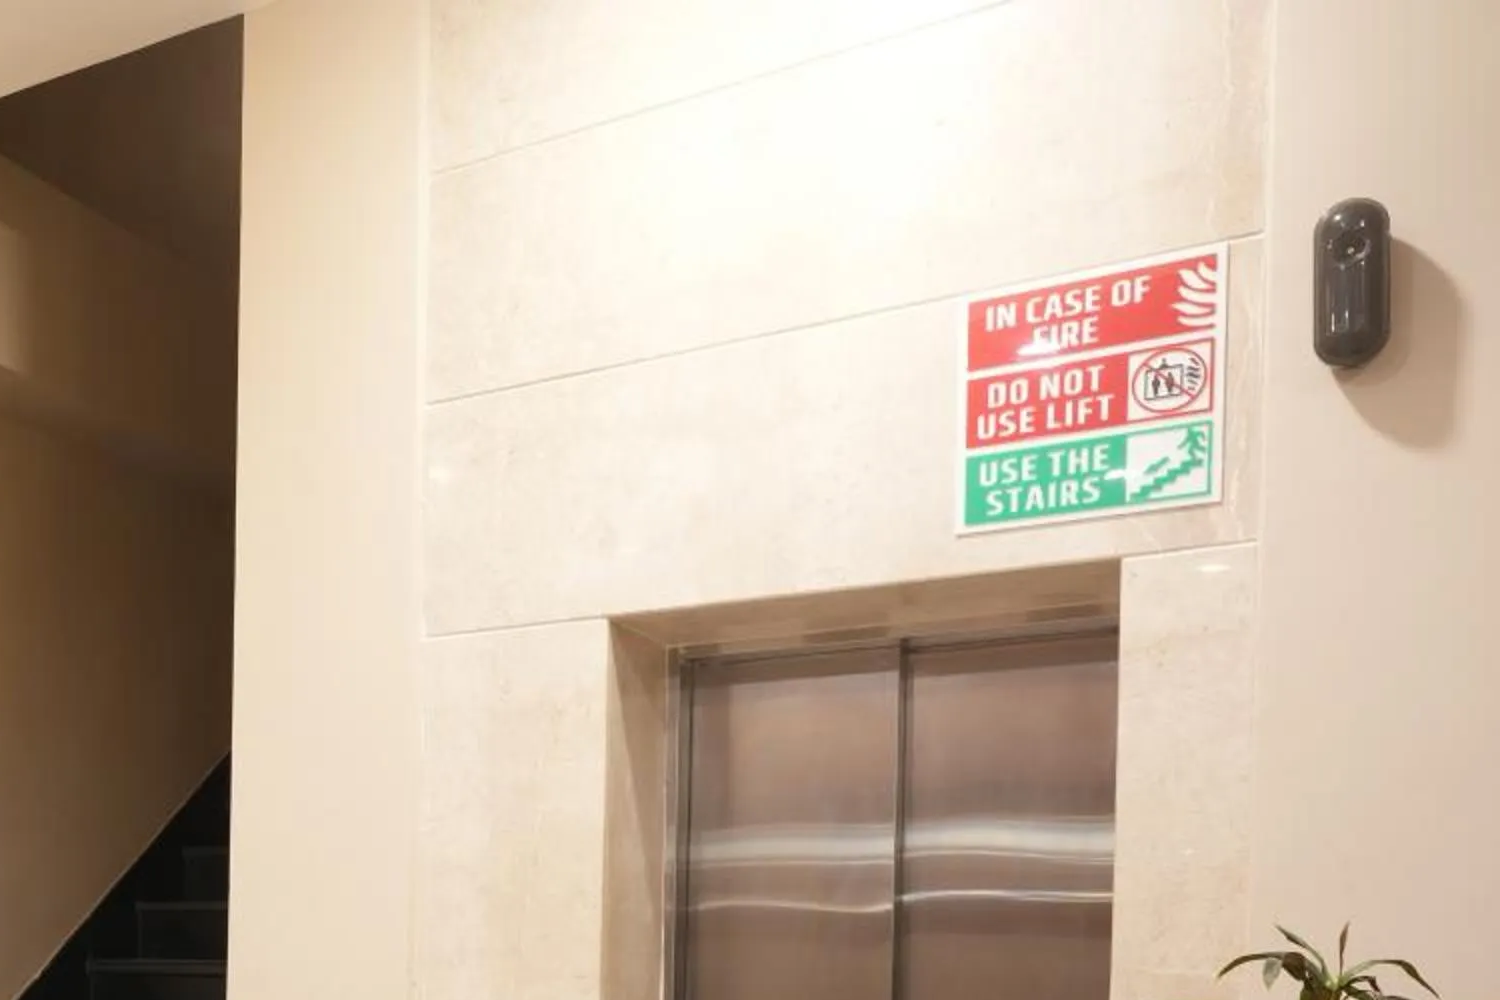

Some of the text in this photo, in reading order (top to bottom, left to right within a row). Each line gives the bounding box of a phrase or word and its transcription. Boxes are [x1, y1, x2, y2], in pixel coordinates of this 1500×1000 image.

[985, 275, 1152, 332] IN CASE OF
[1032, 316, 1099, 351] FIRE
[987, 365, 1105, 409] DO NOT
[976, 394, 1115, 440] USE LIFT
[979, 443, 1111, 487] USE THE
[985, 477, 1101, 516] STAIRS
